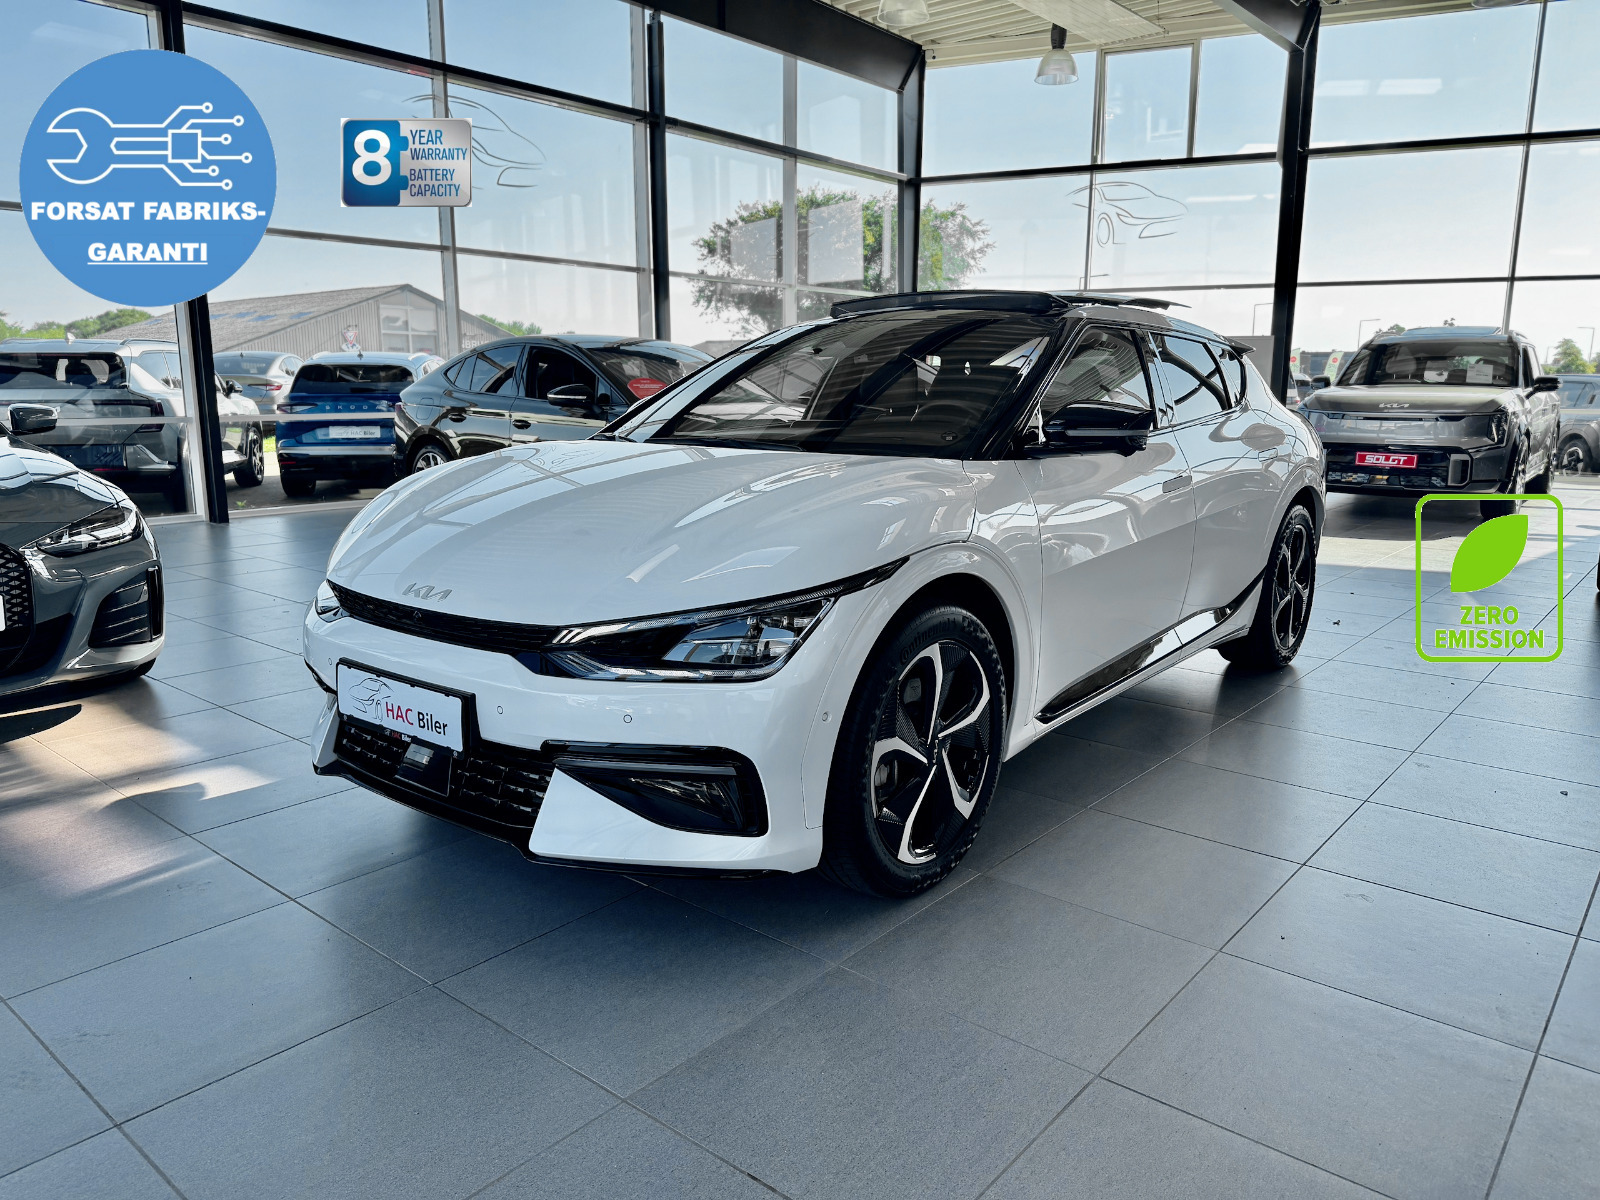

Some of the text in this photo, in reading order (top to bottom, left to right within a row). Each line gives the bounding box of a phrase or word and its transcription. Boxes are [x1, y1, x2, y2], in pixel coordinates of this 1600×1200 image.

[1364, 454, 1408, 465] SOLGT
[402, 582, 453, 602] KIA
[385, 701, 448, 736] HAC Biler
